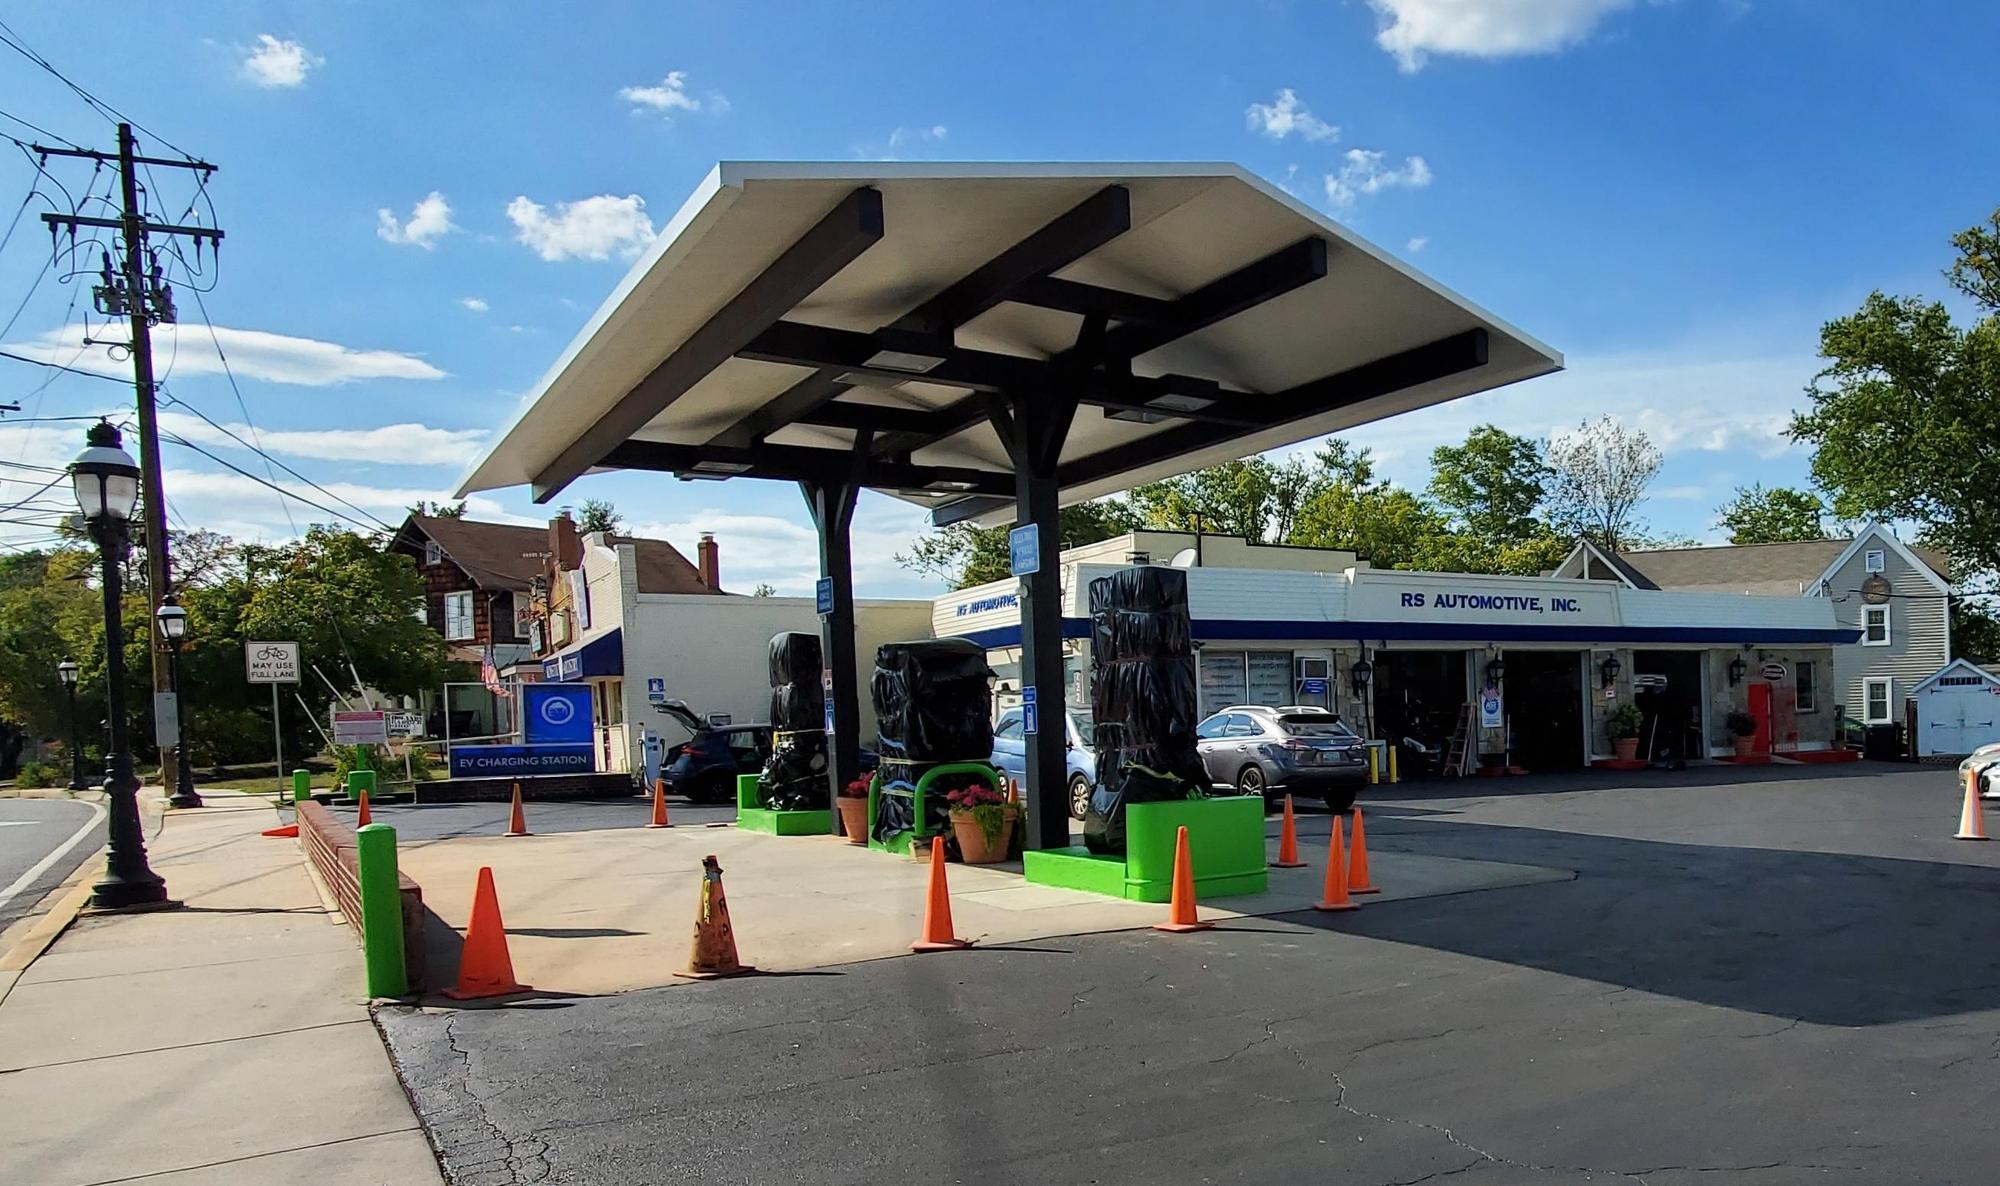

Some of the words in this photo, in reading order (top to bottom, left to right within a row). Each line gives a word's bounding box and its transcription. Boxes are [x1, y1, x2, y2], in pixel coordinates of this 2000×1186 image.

[1401, 593, 1425, 607] RS
[1434, 594, 1544, 614] AUTOMOTIVE,
[1551, 598, 1581, 612] INC.
[460, 759, 474, 768] EV
[476, 757, 539, 767] CHARGING
[542, 755, 587, 765] STATION
